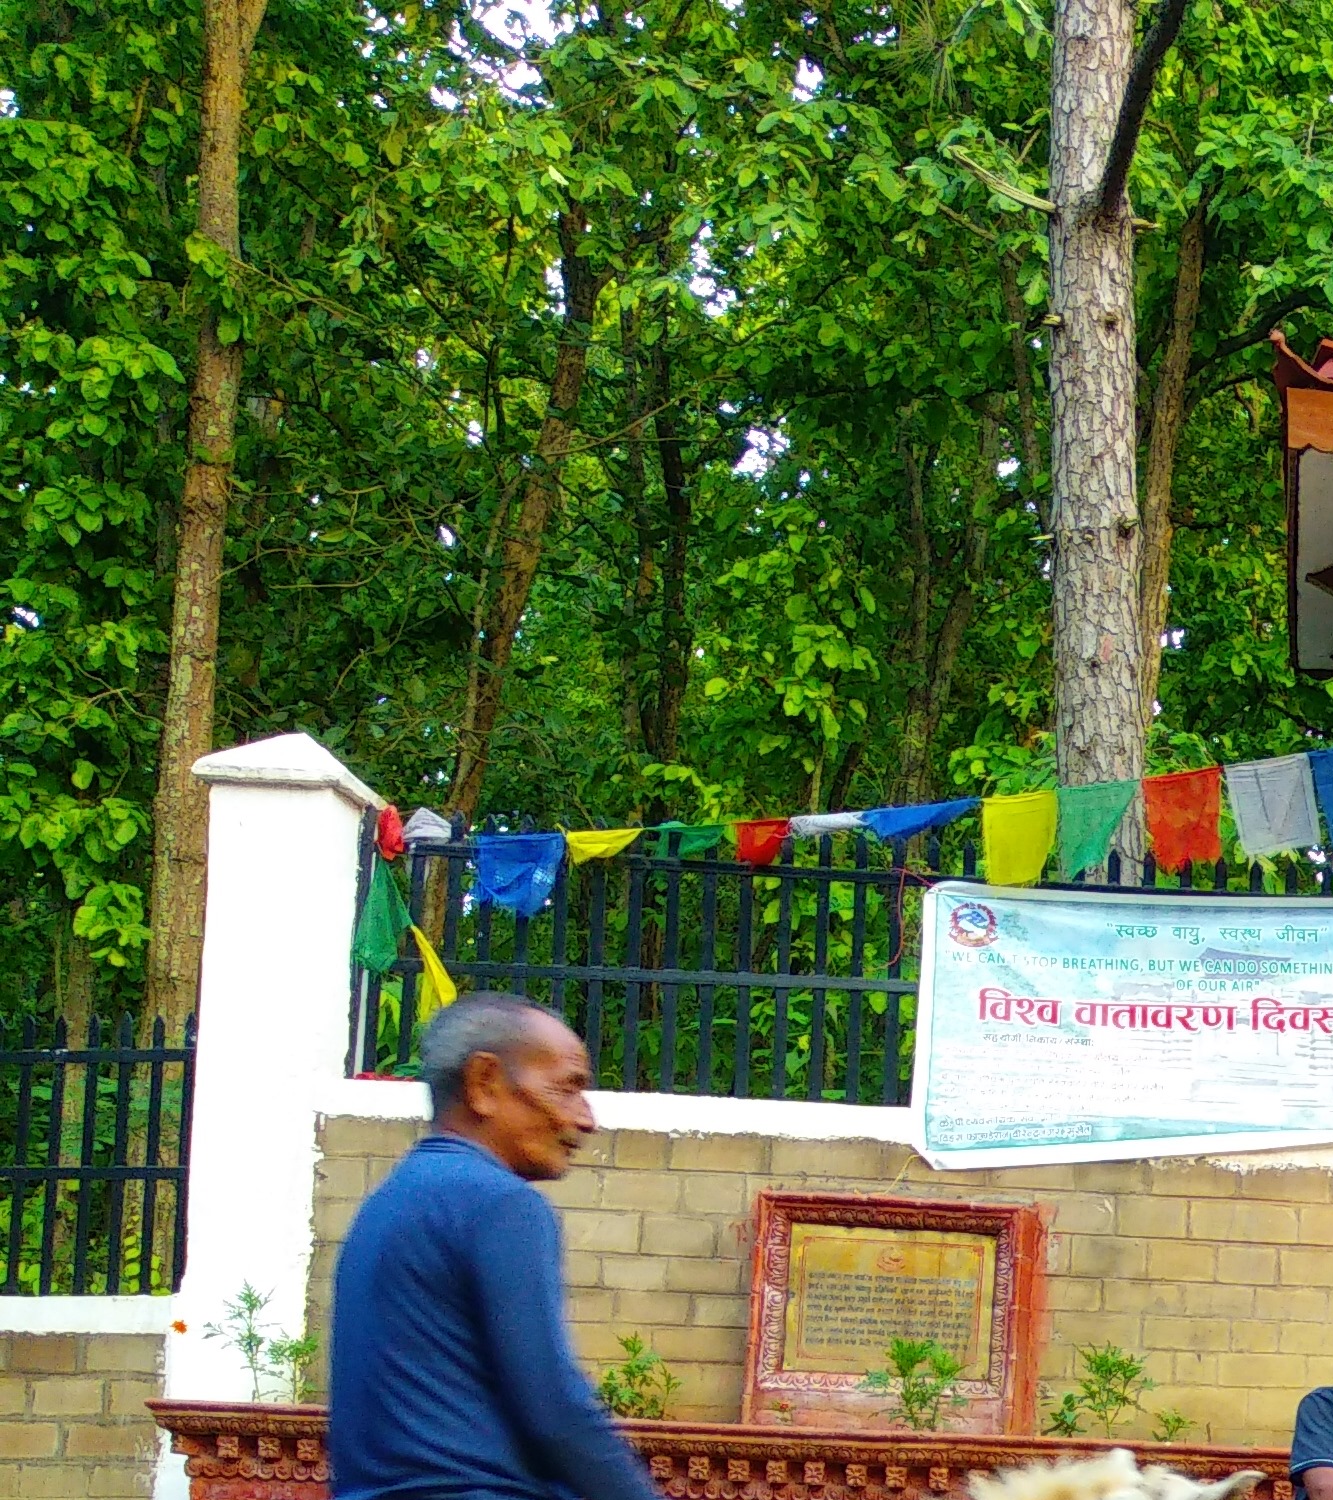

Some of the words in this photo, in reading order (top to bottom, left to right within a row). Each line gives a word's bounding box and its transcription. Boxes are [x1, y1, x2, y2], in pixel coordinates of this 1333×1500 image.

[1219, 927, 1262, 941] स्वस्थ
[1062, 957, 1143, 972] BREATHING,
[1148, 959, 1176, 971] BUT
[1178, 960, 1200, 972] WE
[1205, 960, 1232, 973] CAN
[1237, 961, 1258, 973] DO
[1176, 979, 1194, 991] OF
[1198, 979, 1227, 991] OUR
[977, 987, 1062, 1026] विश्व
[1074, 1000, 1238, 1031] वातावरण
